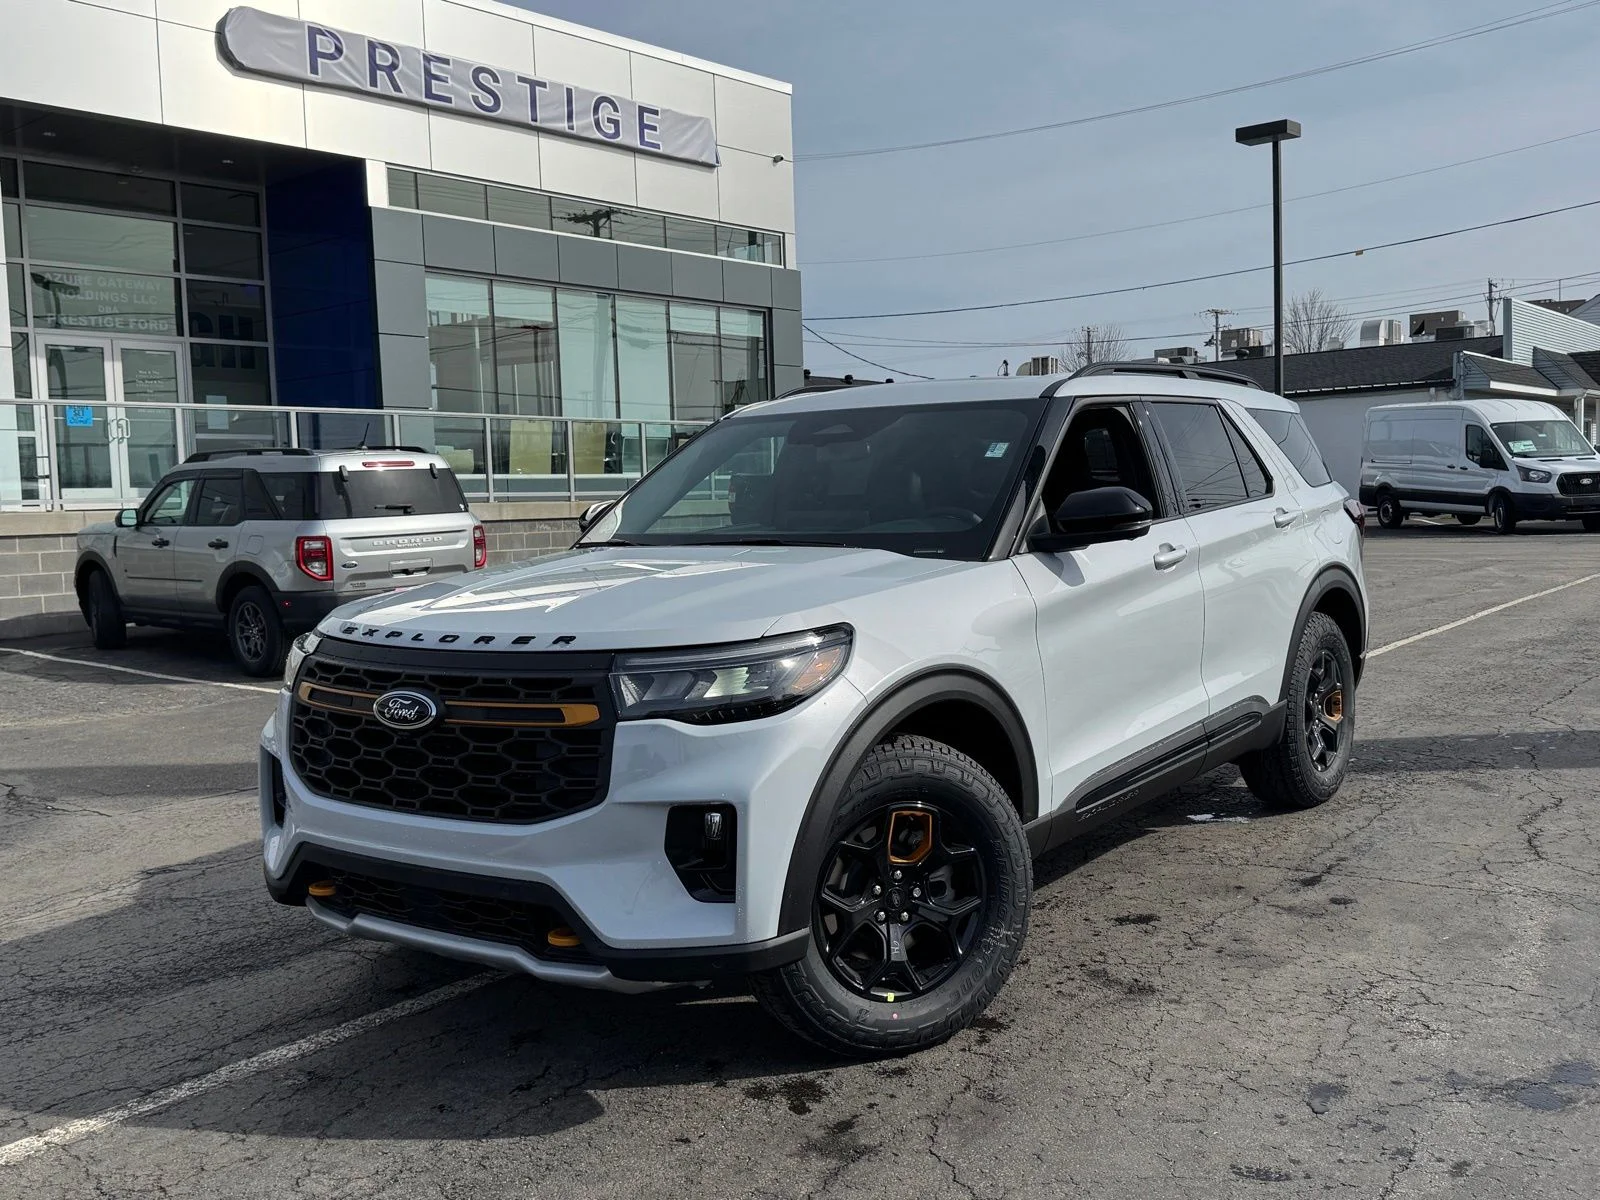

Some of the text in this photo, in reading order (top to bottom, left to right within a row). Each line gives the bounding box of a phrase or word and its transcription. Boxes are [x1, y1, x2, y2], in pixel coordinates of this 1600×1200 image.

[305, 24, 663, 151] PRESTIGE
[45, 272, 161, 292] AZURE GATEWAY
[133, 294, 158, 305] LLC
[98, 304, 119, 314] DBA
[129, 320, 169, 331] FORD
[373, 535, 443, 546] BRONCO
[341, 626, 577, 645] EXPLORER
[385, 698, 419, 720] Ford
